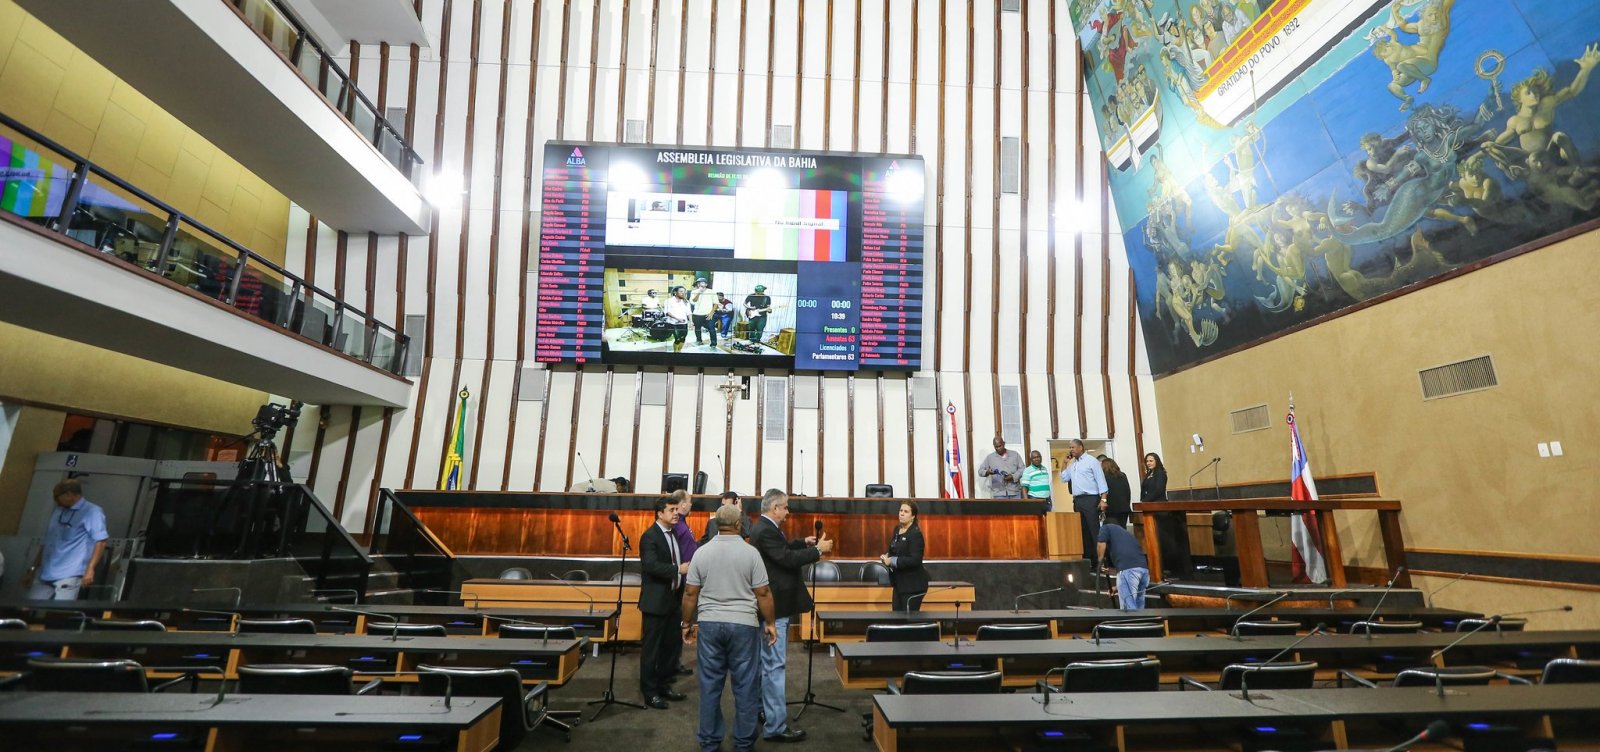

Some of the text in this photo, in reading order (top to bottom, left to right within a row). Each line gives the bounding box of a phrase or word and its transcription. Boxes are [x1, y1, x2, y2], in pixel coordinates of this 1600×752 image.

[1248, 54, 1260, 68] DO
[1260, 35, 1281, 58] POVO
[1283, 17, 1300, 37] 1892
[566, 157, 586, 165] ALBA
[657, 151, 817, 169] ASSEMBLEIA LEGISLATIVA DA BAHIA
[797, 299, 851, 309] 00:00 00:00
[824, 326, 848, 334] Presentes
[848, 335, 856, 343] 63
[819, 344, 847, 352] Licenciados
[850, 344, 855, 352] 0
[812, 352, 855, 361] Parlamentares 63
